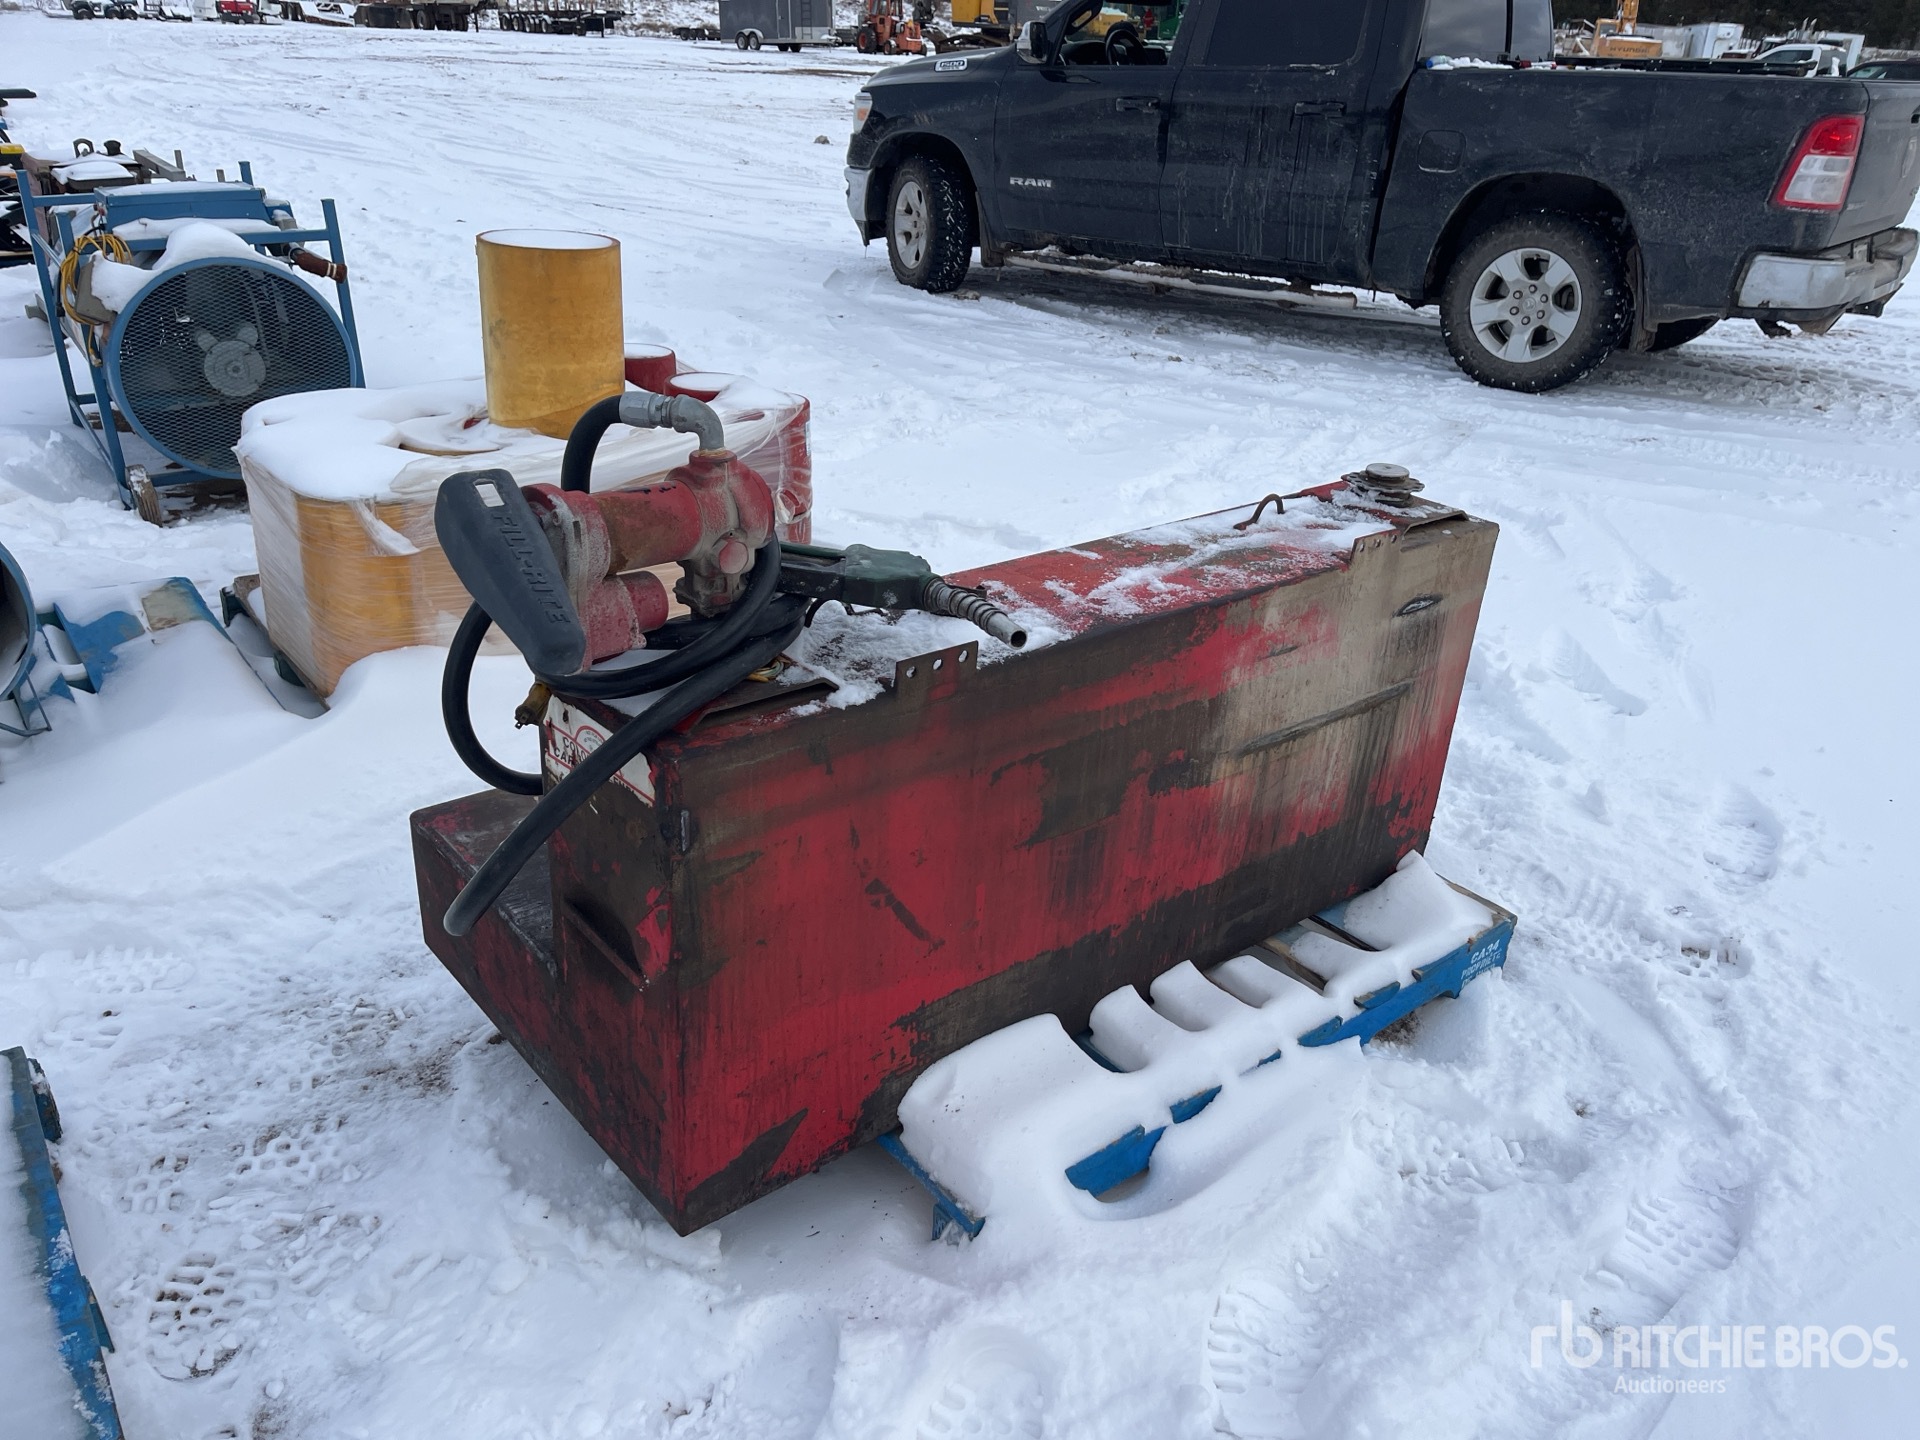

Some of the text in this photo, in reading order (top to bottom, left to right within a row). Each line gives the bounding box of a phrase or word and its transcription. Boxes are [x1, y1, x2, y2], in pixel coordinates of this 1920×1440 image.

[1010, 177, 1052, 188] RAM
[491, 512, 572, 624] FILL-RITE
[562, 736, 591, 763] COLO
